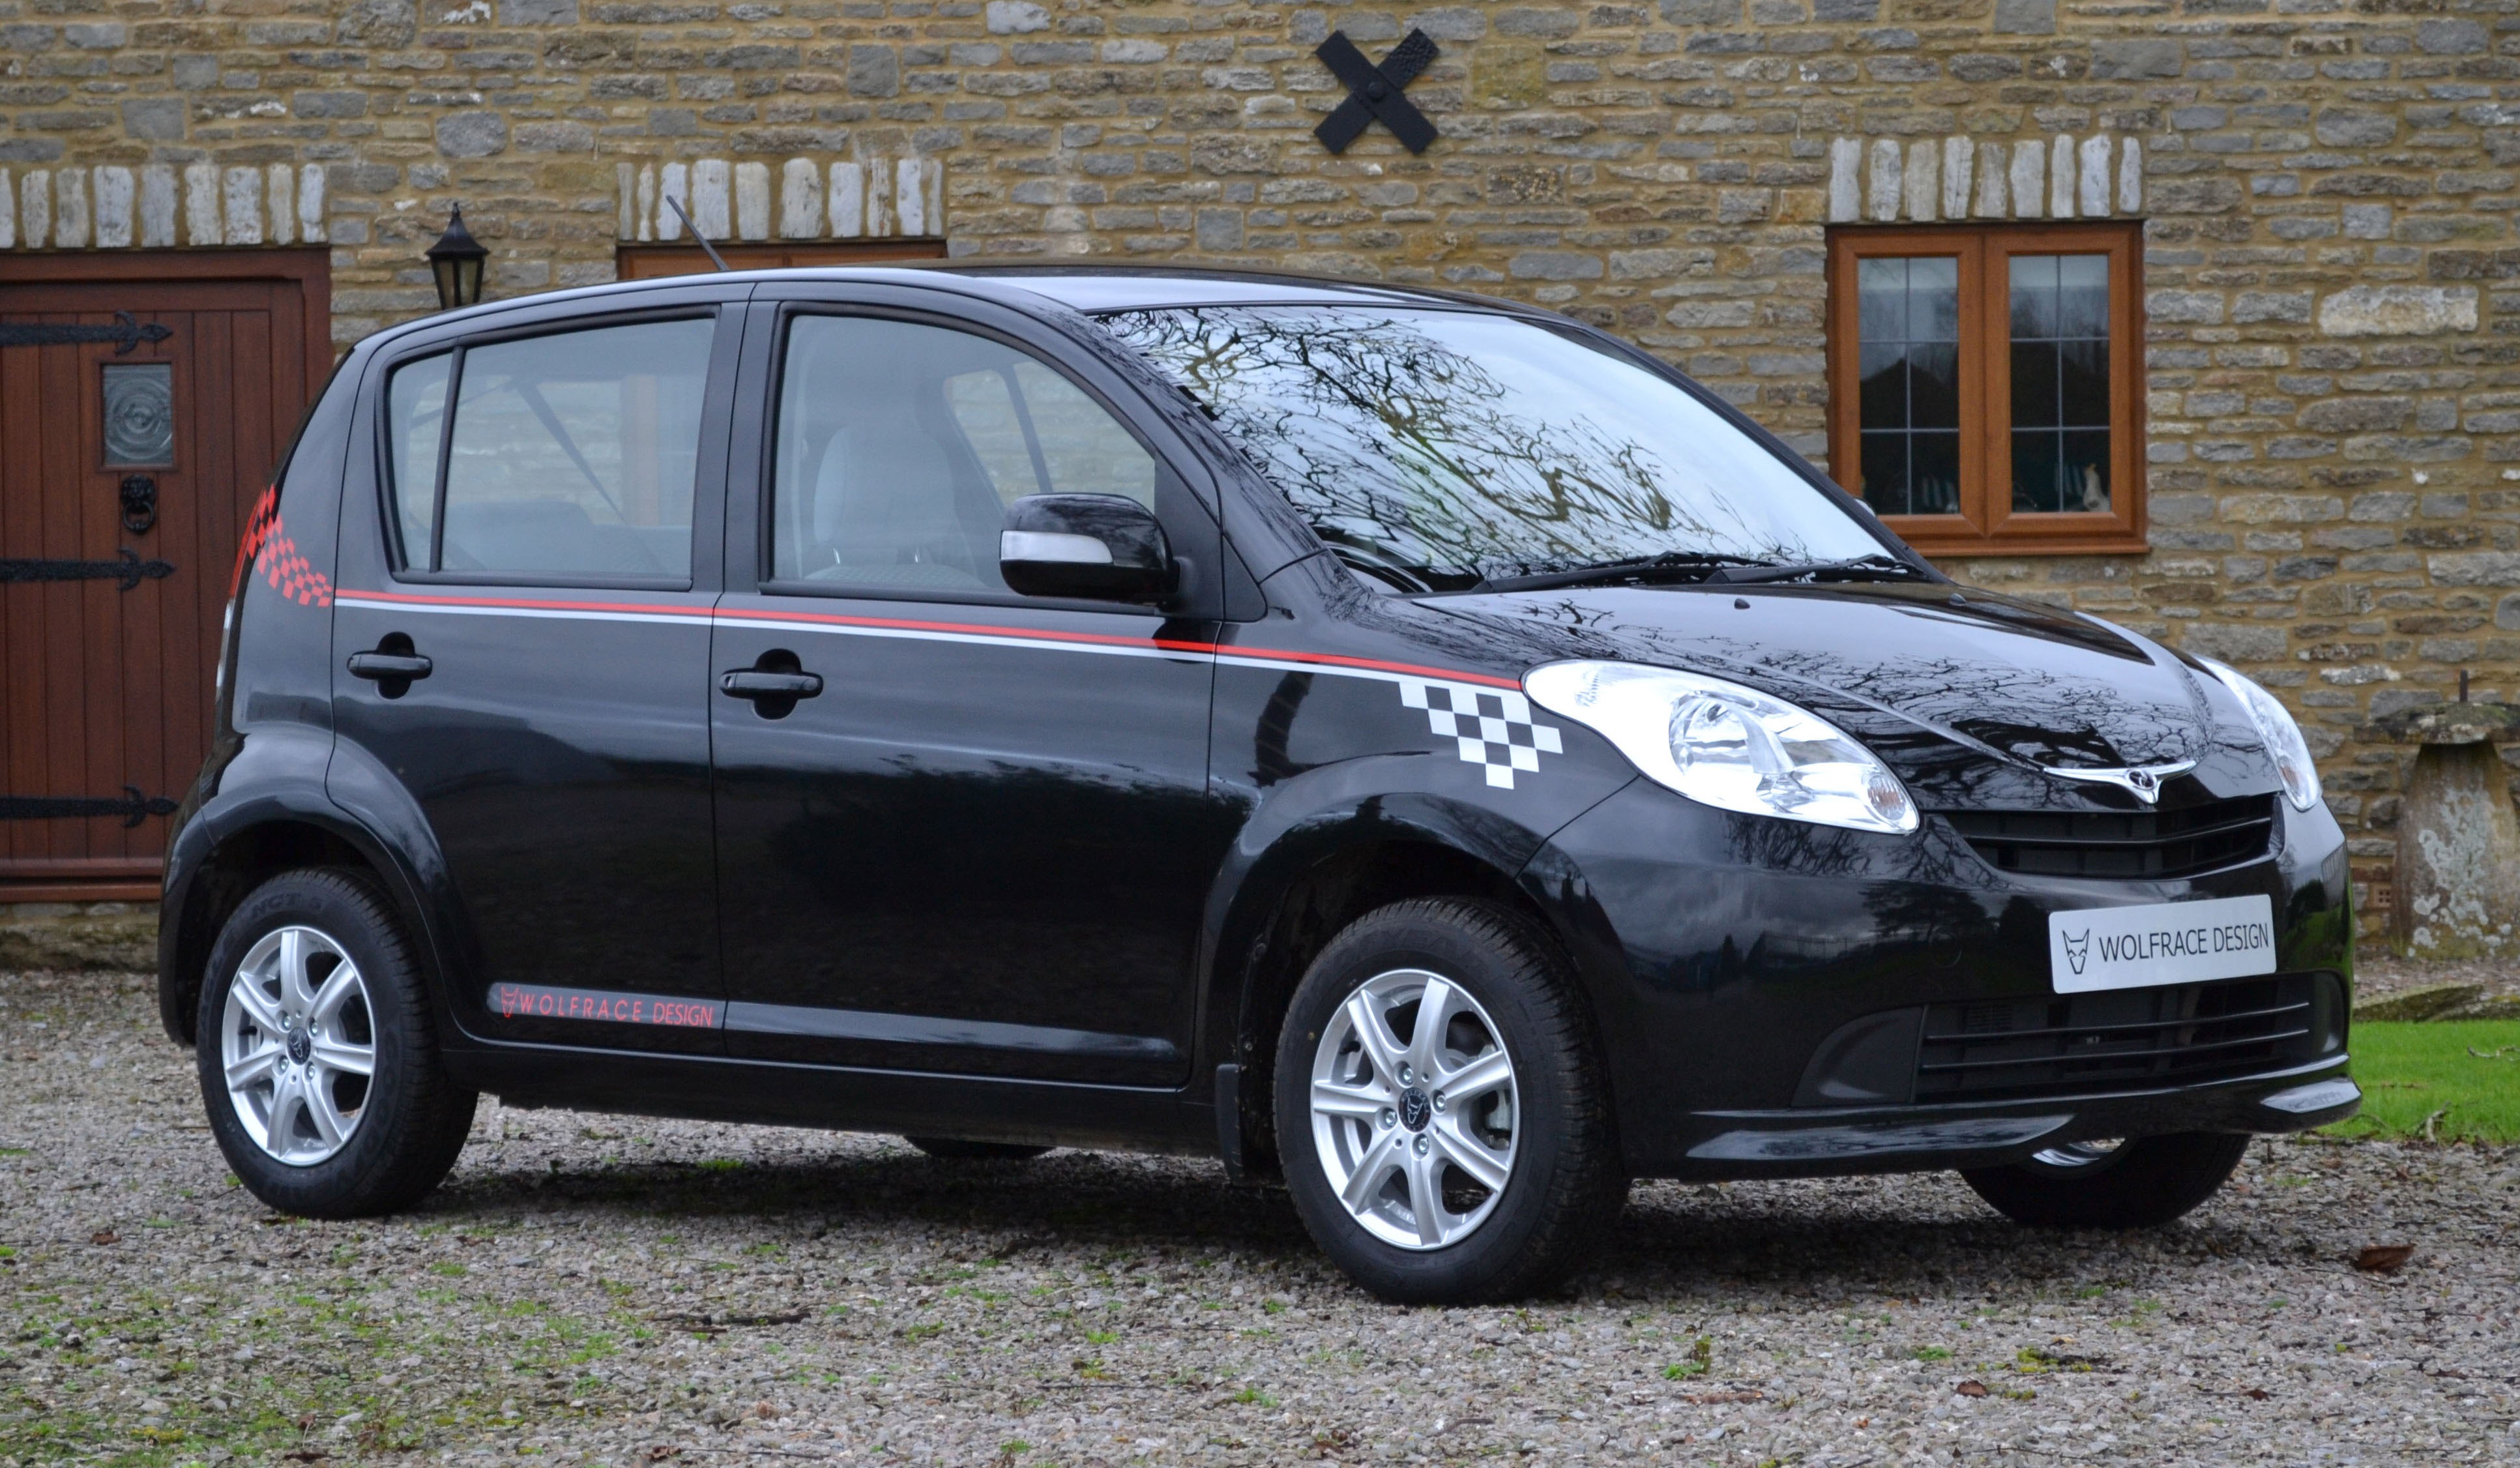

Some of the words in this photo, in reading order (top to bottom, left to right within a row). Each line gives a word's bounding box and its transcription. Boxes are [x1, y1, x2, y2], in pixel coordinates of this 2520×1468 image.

[2099, 929, 2208, 962] WOLFRACE
[2214, 923, 2269, 953] DESIGN
[520, 994, 642, 1022] WOLFRACE
[652, 1002, 714, 1027] DESIGN
